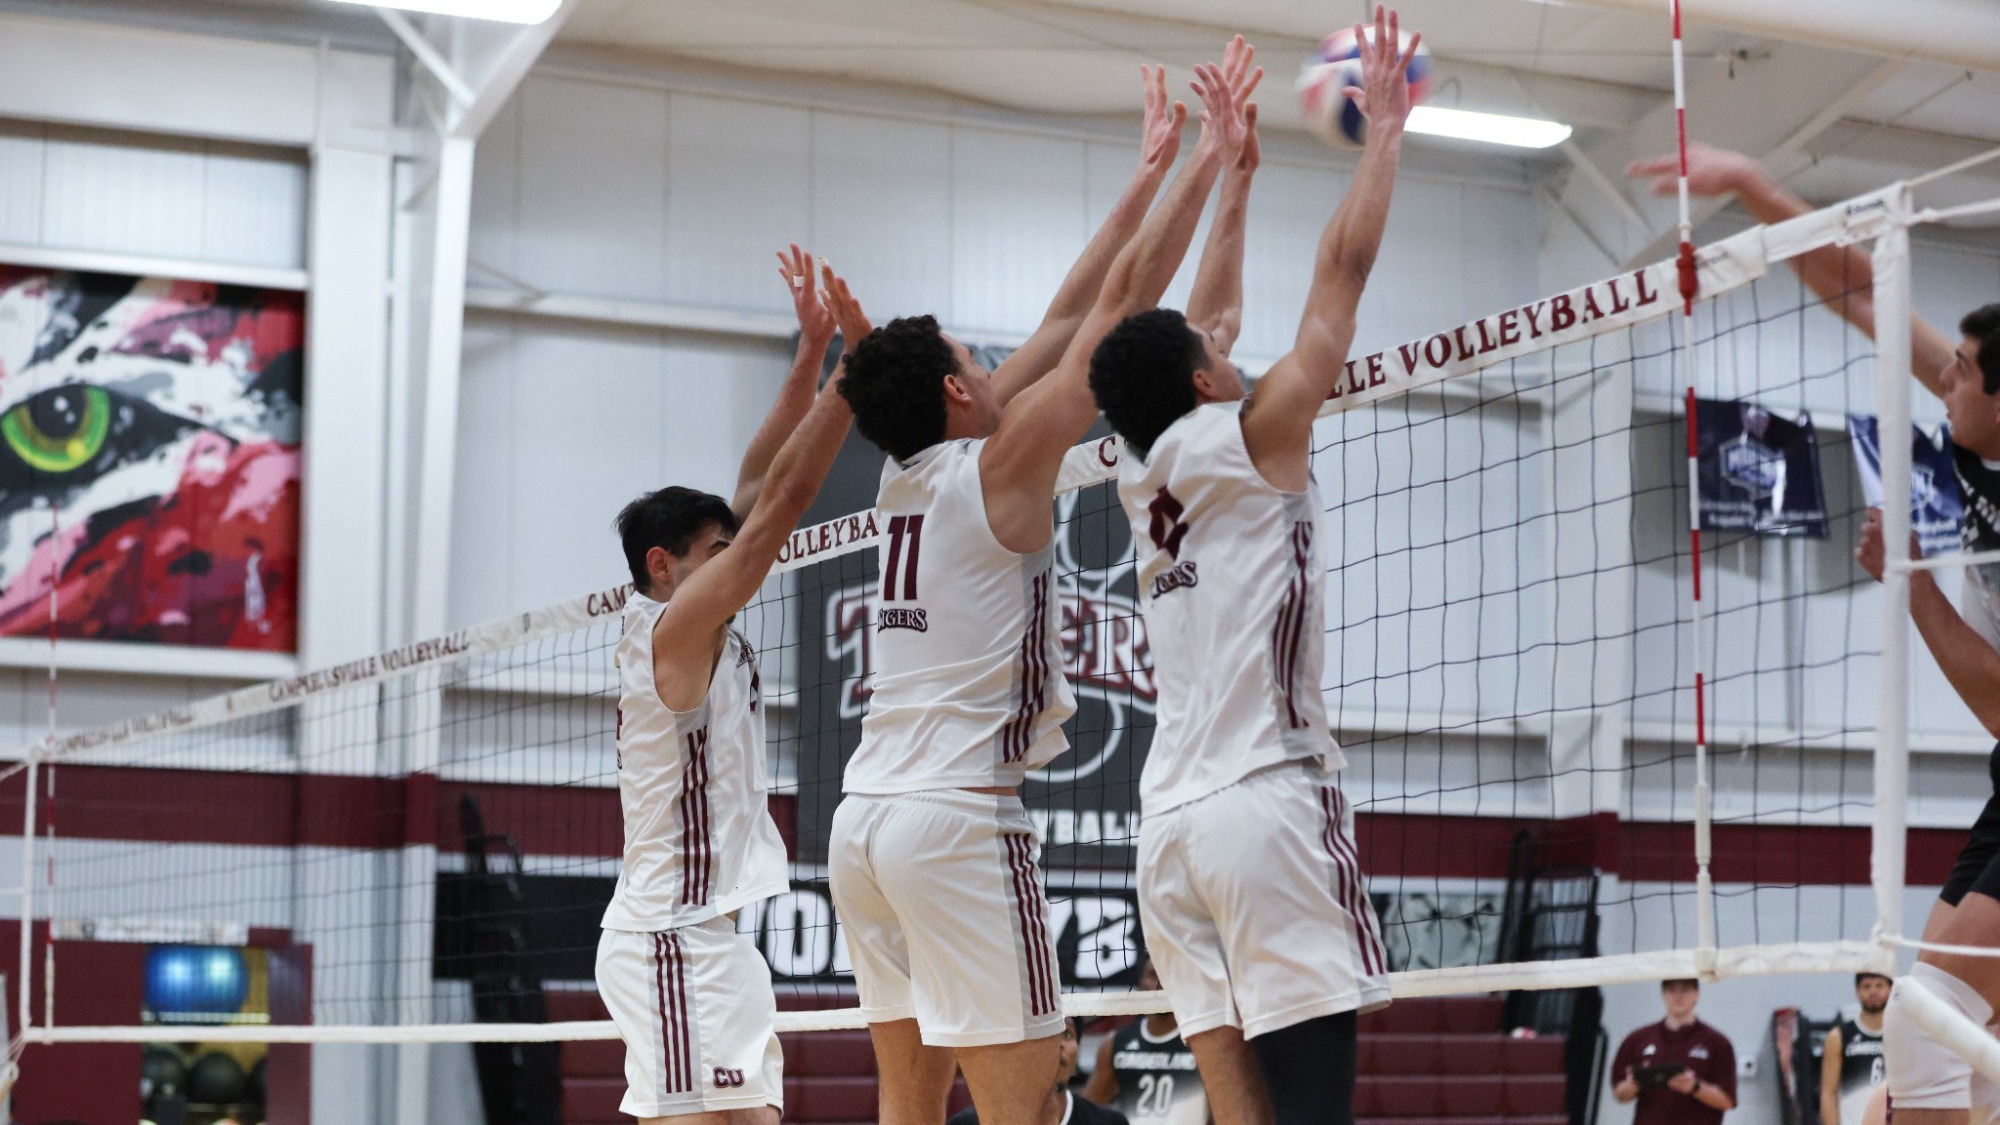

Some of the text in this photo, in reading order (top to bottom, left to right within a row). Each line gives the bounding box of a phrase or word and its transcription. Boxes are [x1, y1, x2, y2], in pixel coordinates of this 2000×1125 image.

[1398, 270, 1658, 377] VOLLEYBALL
[776, 511, 879, 564] OLLEYBA
[884, 514, 925, 601] 11
[878, 608, 928, 633] IGERS
[713, 1066, 745, 1088] CU
[1137, 1073, 1175, 1118] 20
